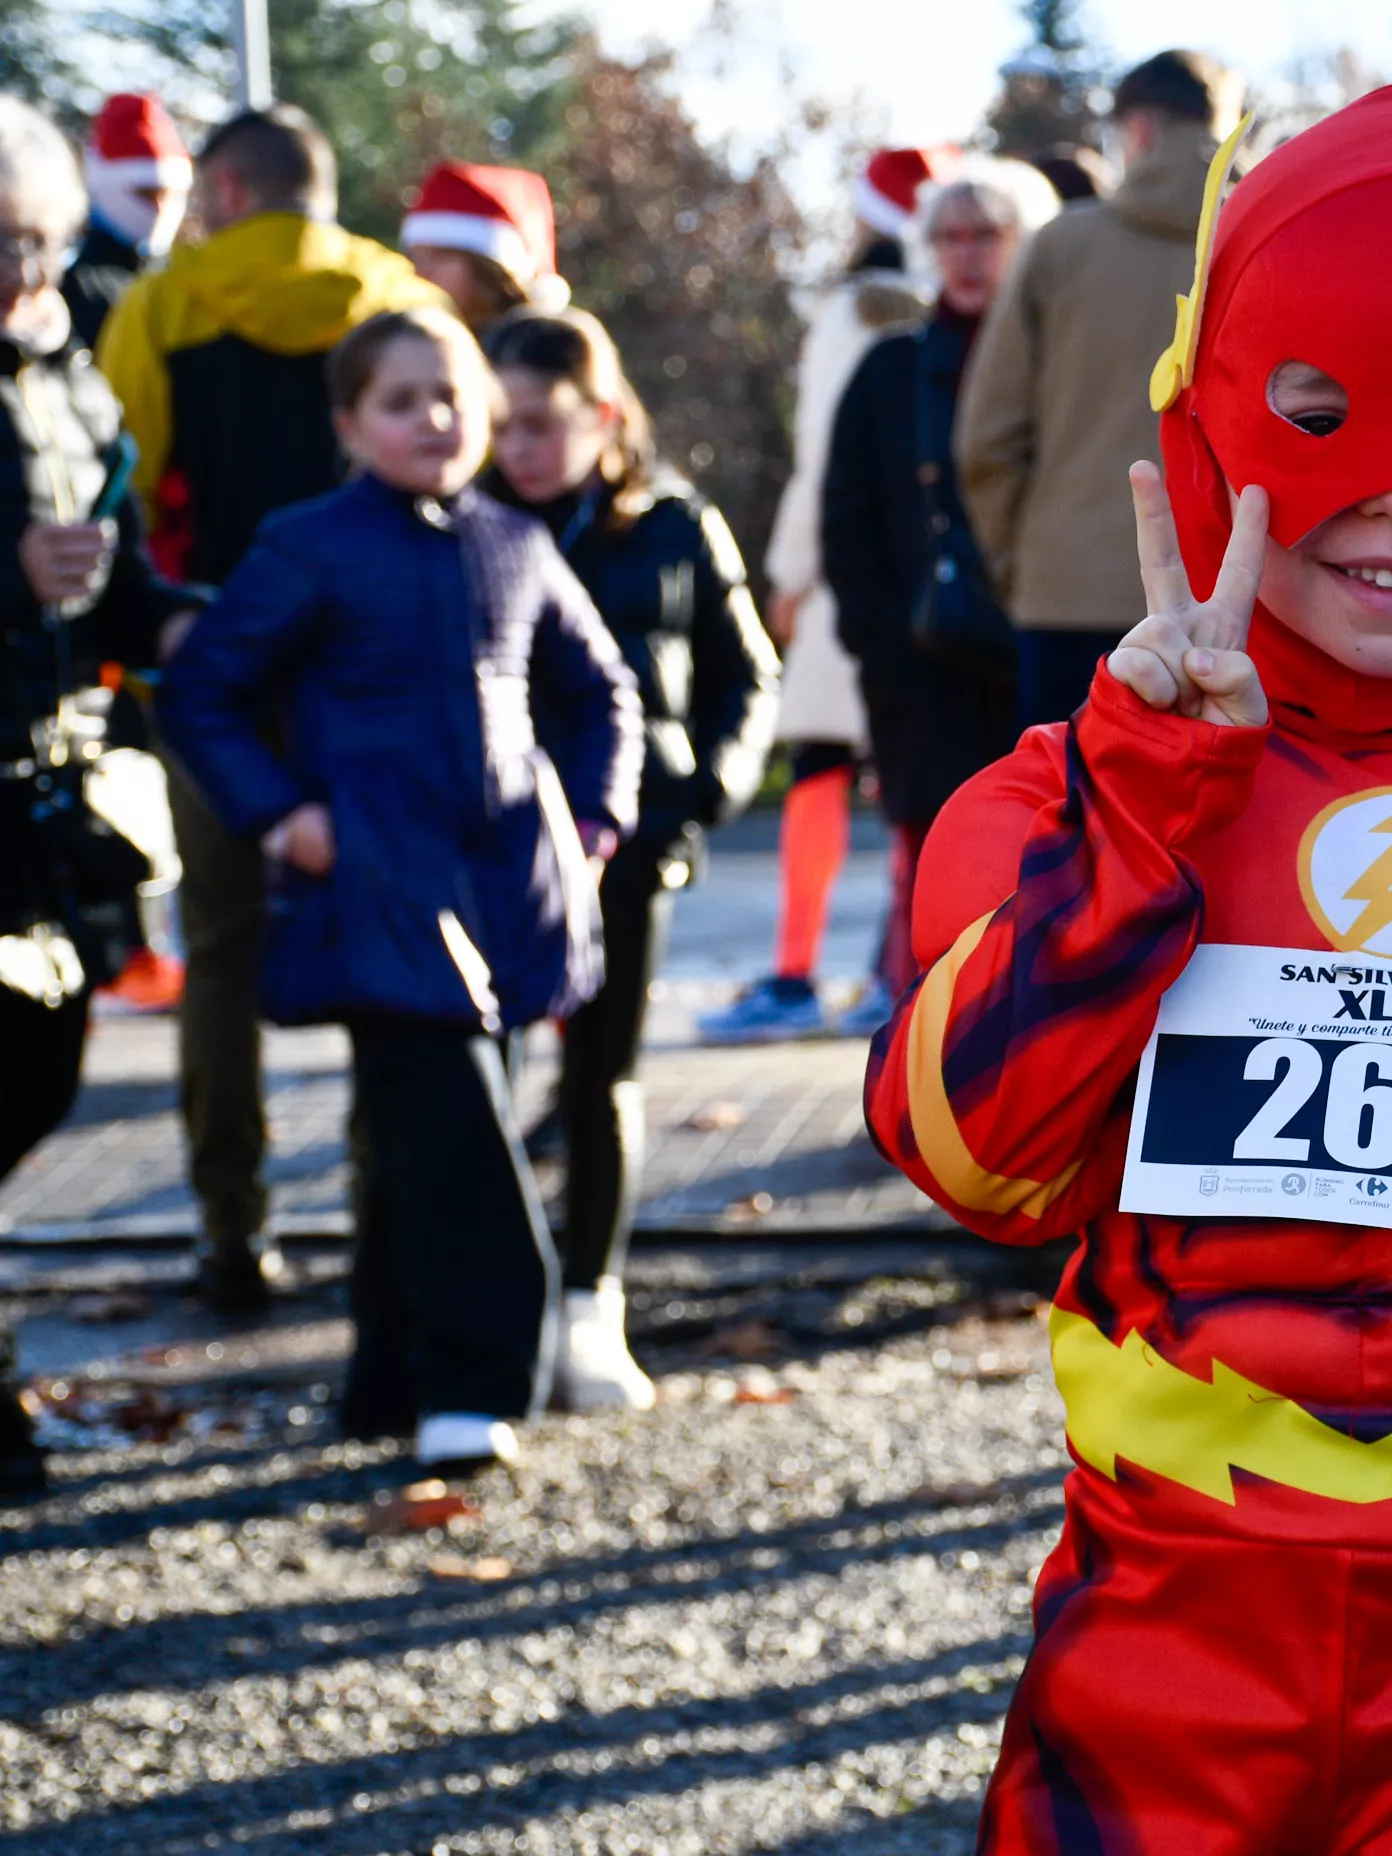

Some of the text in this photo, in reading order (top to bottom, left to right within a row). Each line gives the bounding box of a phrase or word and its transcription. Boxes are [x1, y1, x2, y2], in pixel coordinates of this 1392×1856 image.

[1280, 964, 1337, 983] SAN
[1296, 1023, 1308, 1036] y
[1311, 1024, 1379, 1037] comparte
[1349, 1197, 1391, 1209] Carrefour
